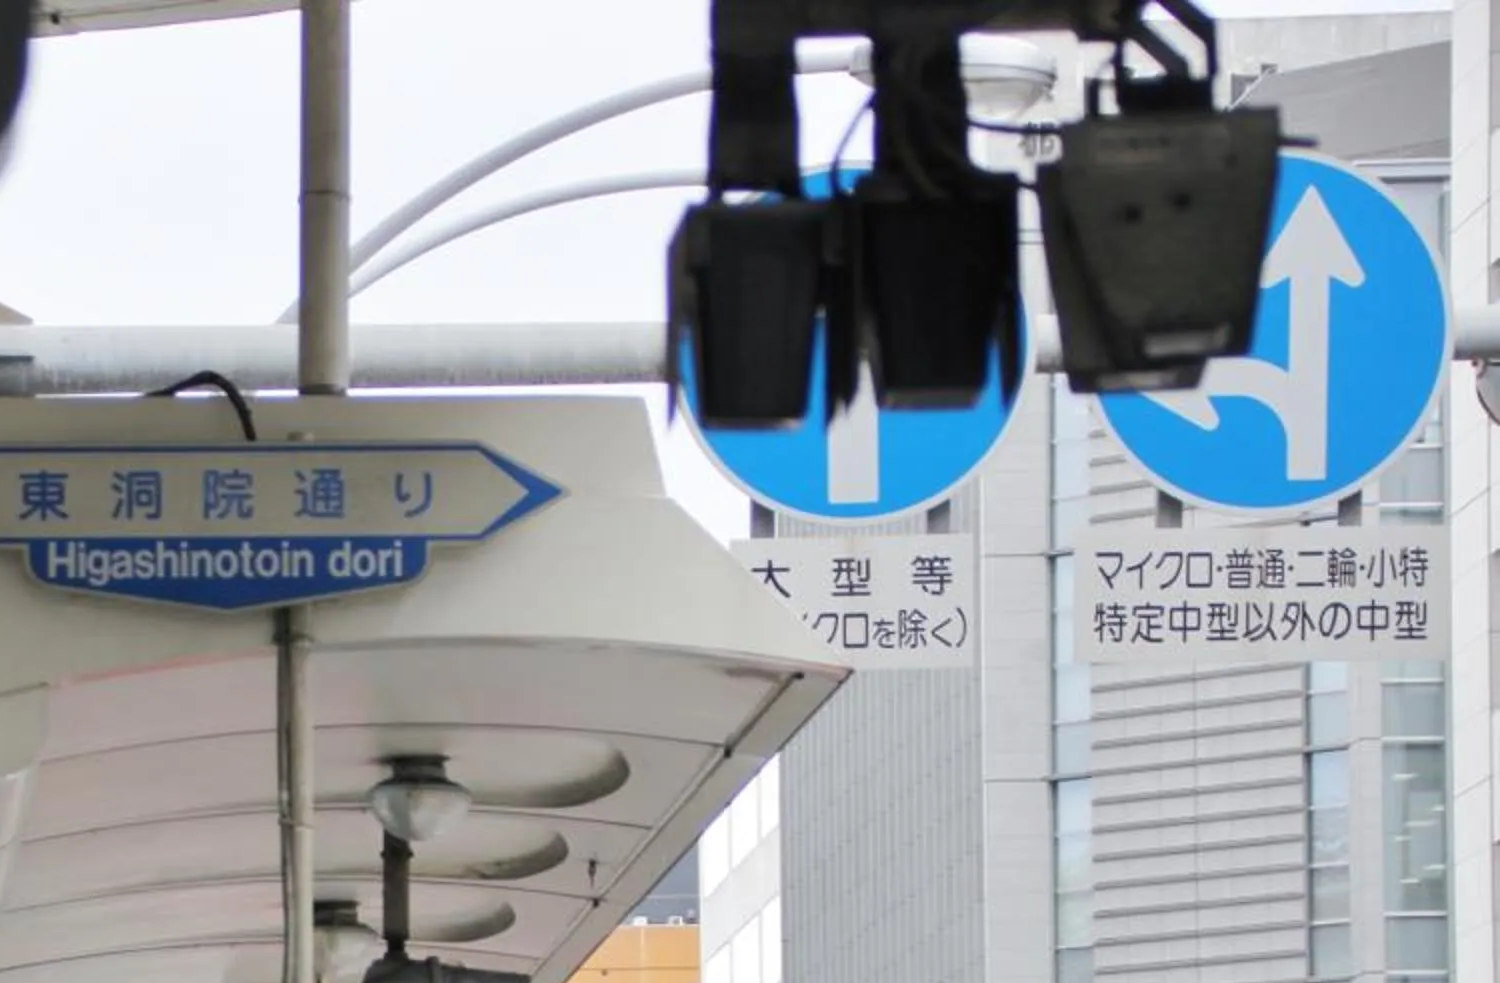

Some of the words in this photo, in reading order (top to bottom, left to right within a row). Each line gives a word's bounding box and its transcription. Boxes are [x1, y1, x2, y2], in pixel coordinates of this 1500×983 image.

[18, 468, 433, 522] 東洞院通り
[46, 539, 315, 586] Higashinotoin
[329, 539, 402, 578] dori
[1092, 600, 1428, 643] 特定中型以外の中型
